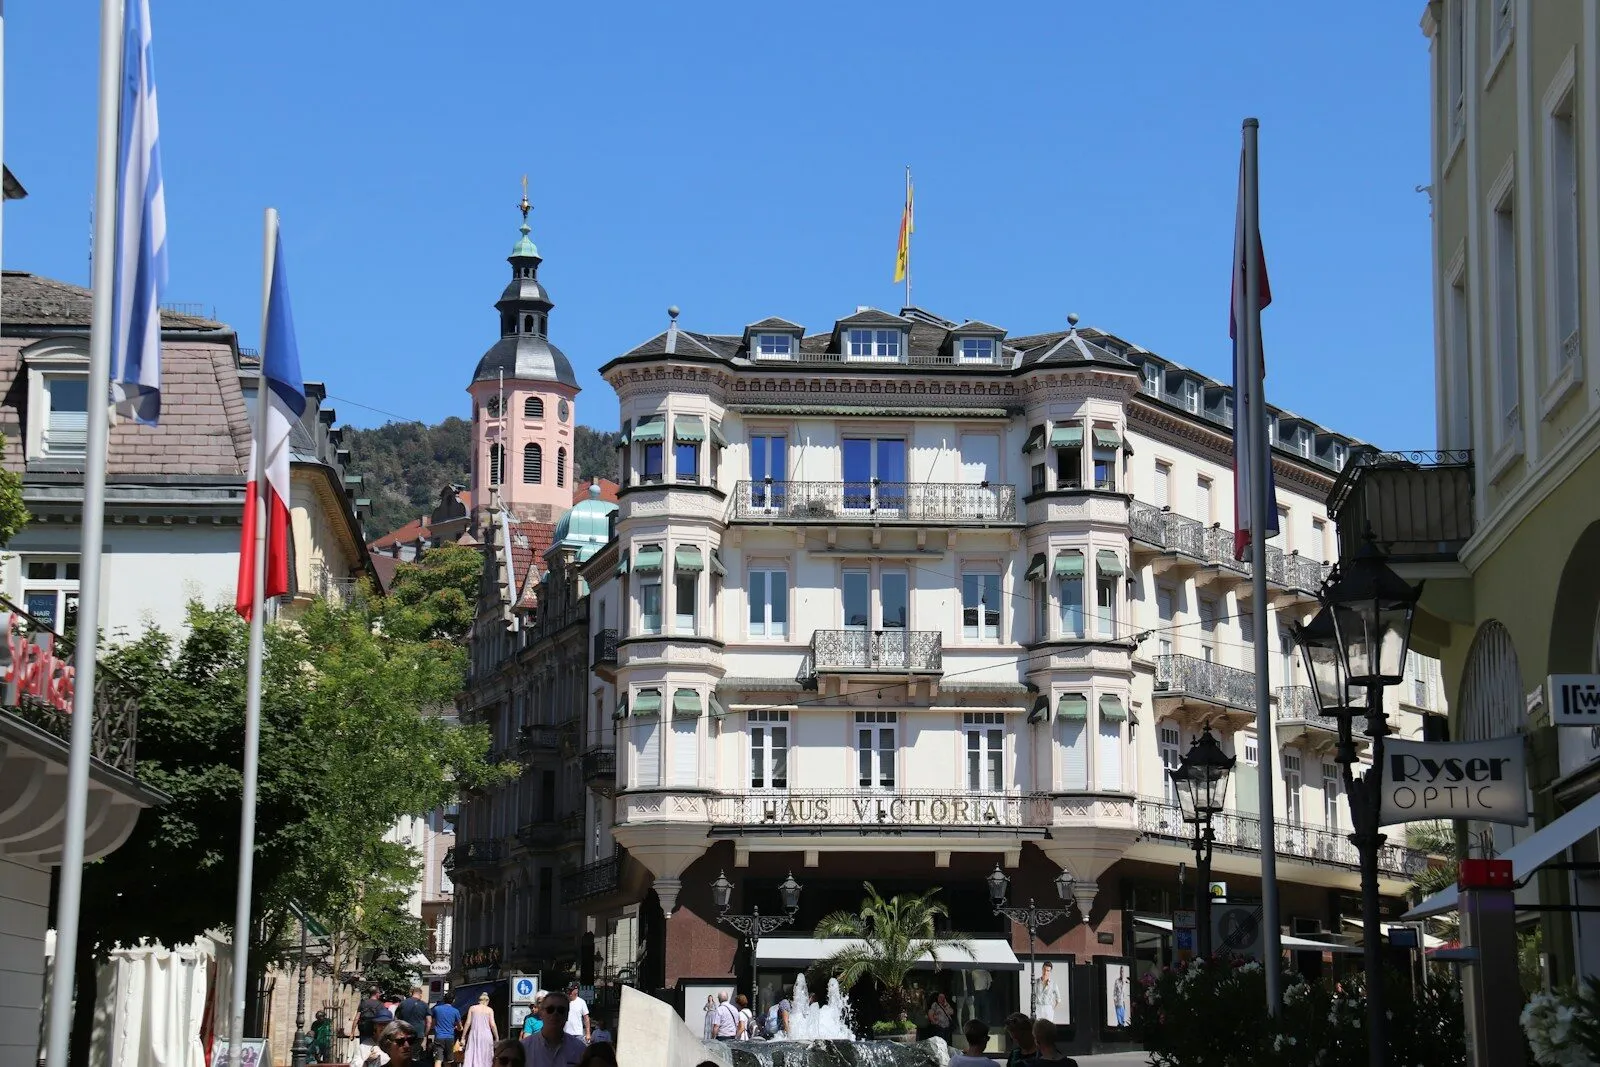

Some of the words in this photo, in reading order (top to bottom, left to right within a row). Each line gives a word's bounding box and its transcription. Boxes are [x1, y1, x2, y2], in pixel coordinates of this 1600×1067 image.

[1390, 754, 1511, 783] Ryser
[1393, 786, 1493, 809] OPTIC
[763, 799, 829, 822] HAUS
[852, 799, 1000, 823] VICTORIA
